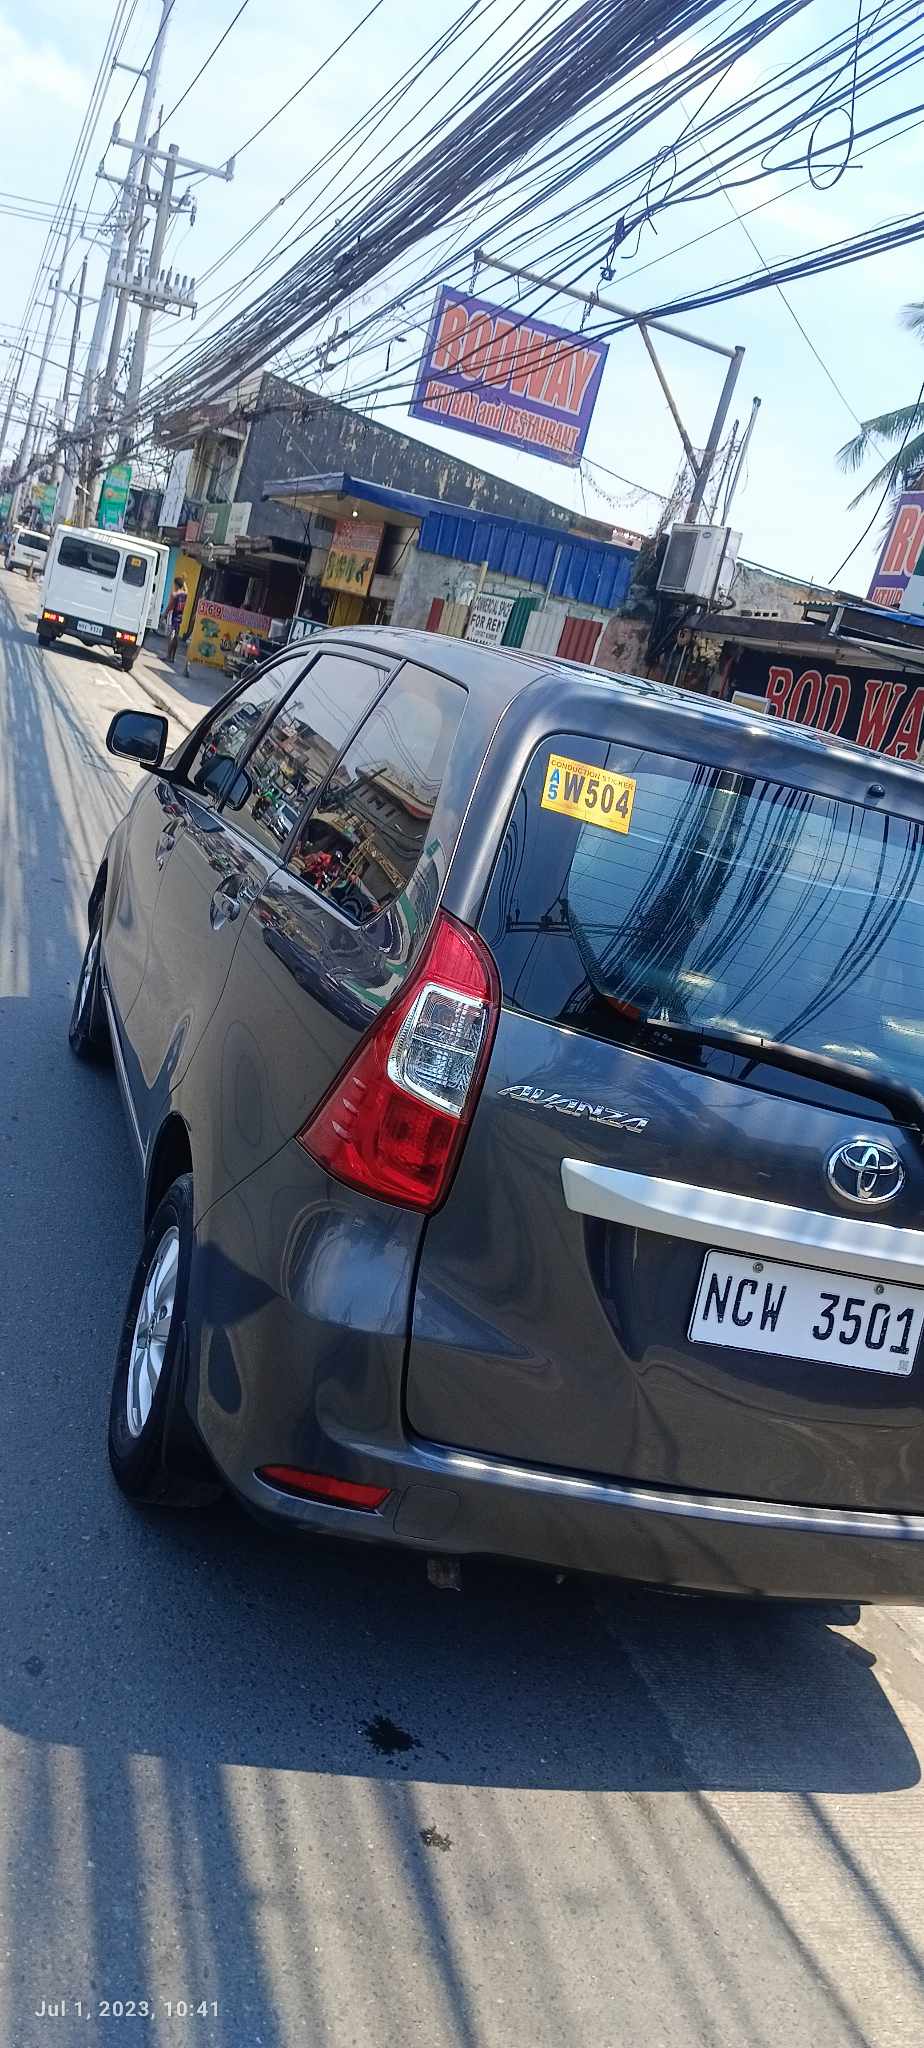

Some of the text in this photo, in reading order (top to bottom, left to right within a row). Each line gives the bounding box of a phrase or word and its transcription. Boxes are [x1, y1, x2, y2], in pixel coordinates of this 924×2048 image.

[431, 300, 601, 416] RODWAY
[451, 389, 480, 421] BAR
[477, 400, 505, 430] and
[503, 403, 581, 454] RESTAURANT
[470, 614, 506, 633] FOR RENT
[551, 759, 634, 790] CONDUCTION STICKER
[563, 771, 630, 819] W504
[496, 1083, 650, 1134] AVANZA
[702, 1272, 915, 1355] NCW 3501
